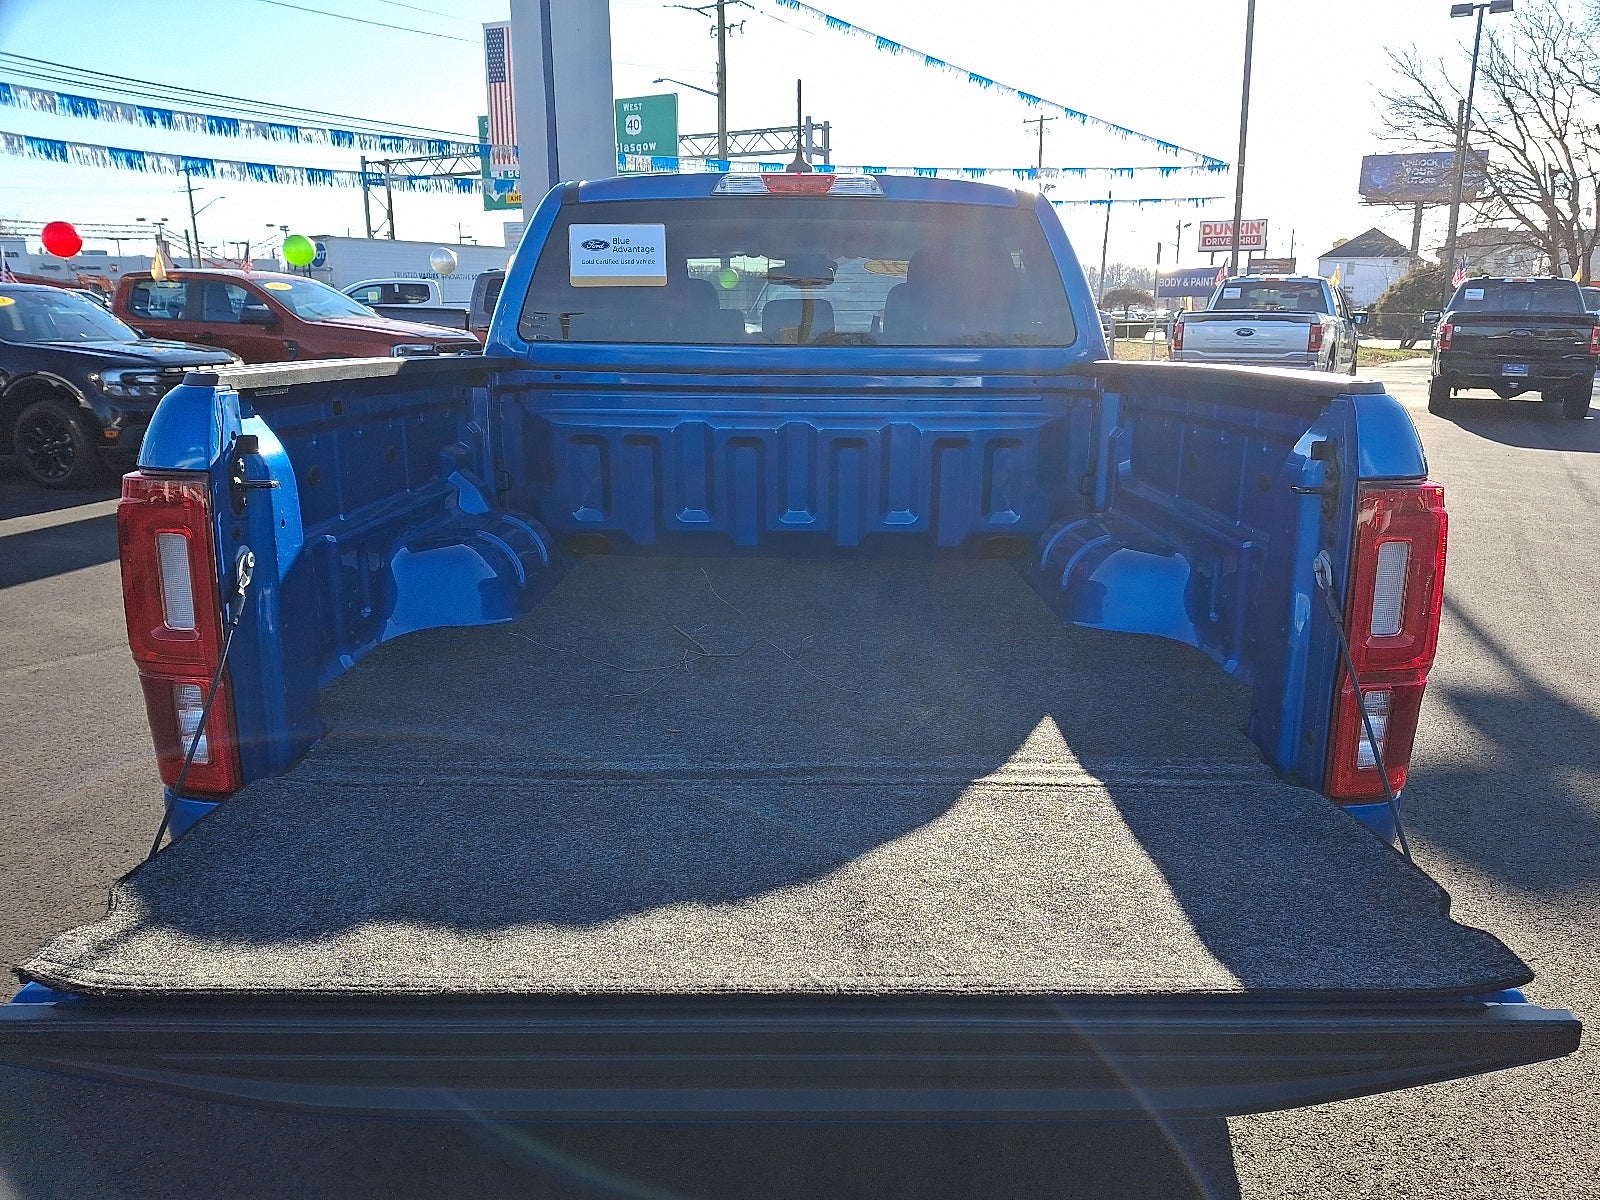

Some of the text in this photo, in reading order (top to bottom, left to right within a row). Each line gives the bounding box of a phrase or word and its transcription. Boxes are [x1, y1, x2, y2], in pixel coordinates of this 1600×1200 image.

[623, 102, 642, 111] WEST
[627, 119, 640, 130] 40
[612, 237, 630, 245] Blue
[1239, 236, 1258, 245] HRU
[612, 246, 655, 255] Advantage
[393, 271, 417, 279] TRUSTED
[1159, 276, 1215, 287] BODY & PAINT
